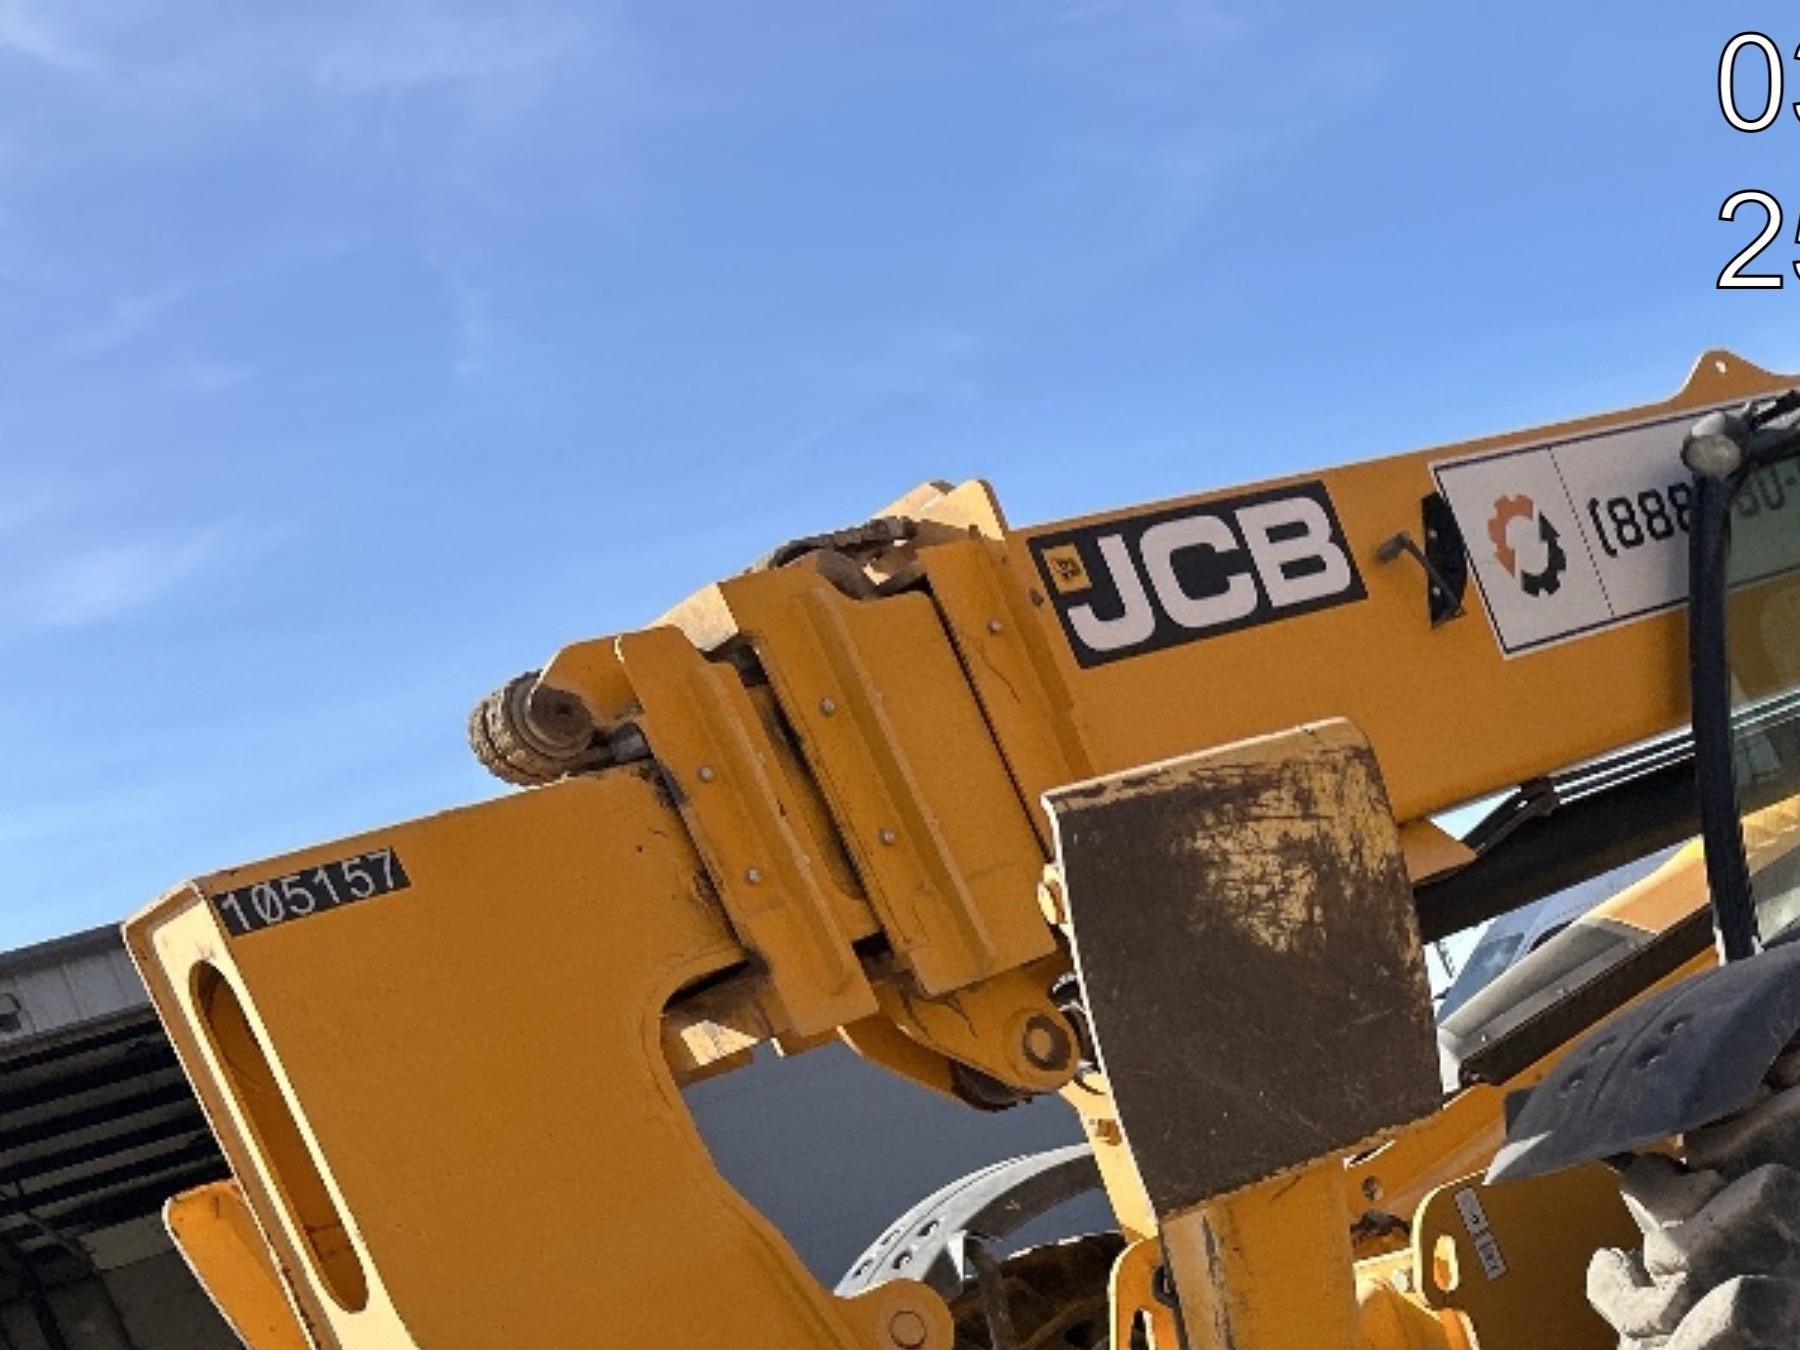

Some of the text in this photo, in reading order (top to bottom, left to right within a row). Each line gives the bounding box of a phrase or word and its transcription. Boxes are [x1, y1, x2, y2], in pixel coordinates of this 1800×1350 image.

[1586, 478, 1696, 558] (888
[1066, 496, 1352, 652] JCB
[220, 847, 397, 932] 105157
